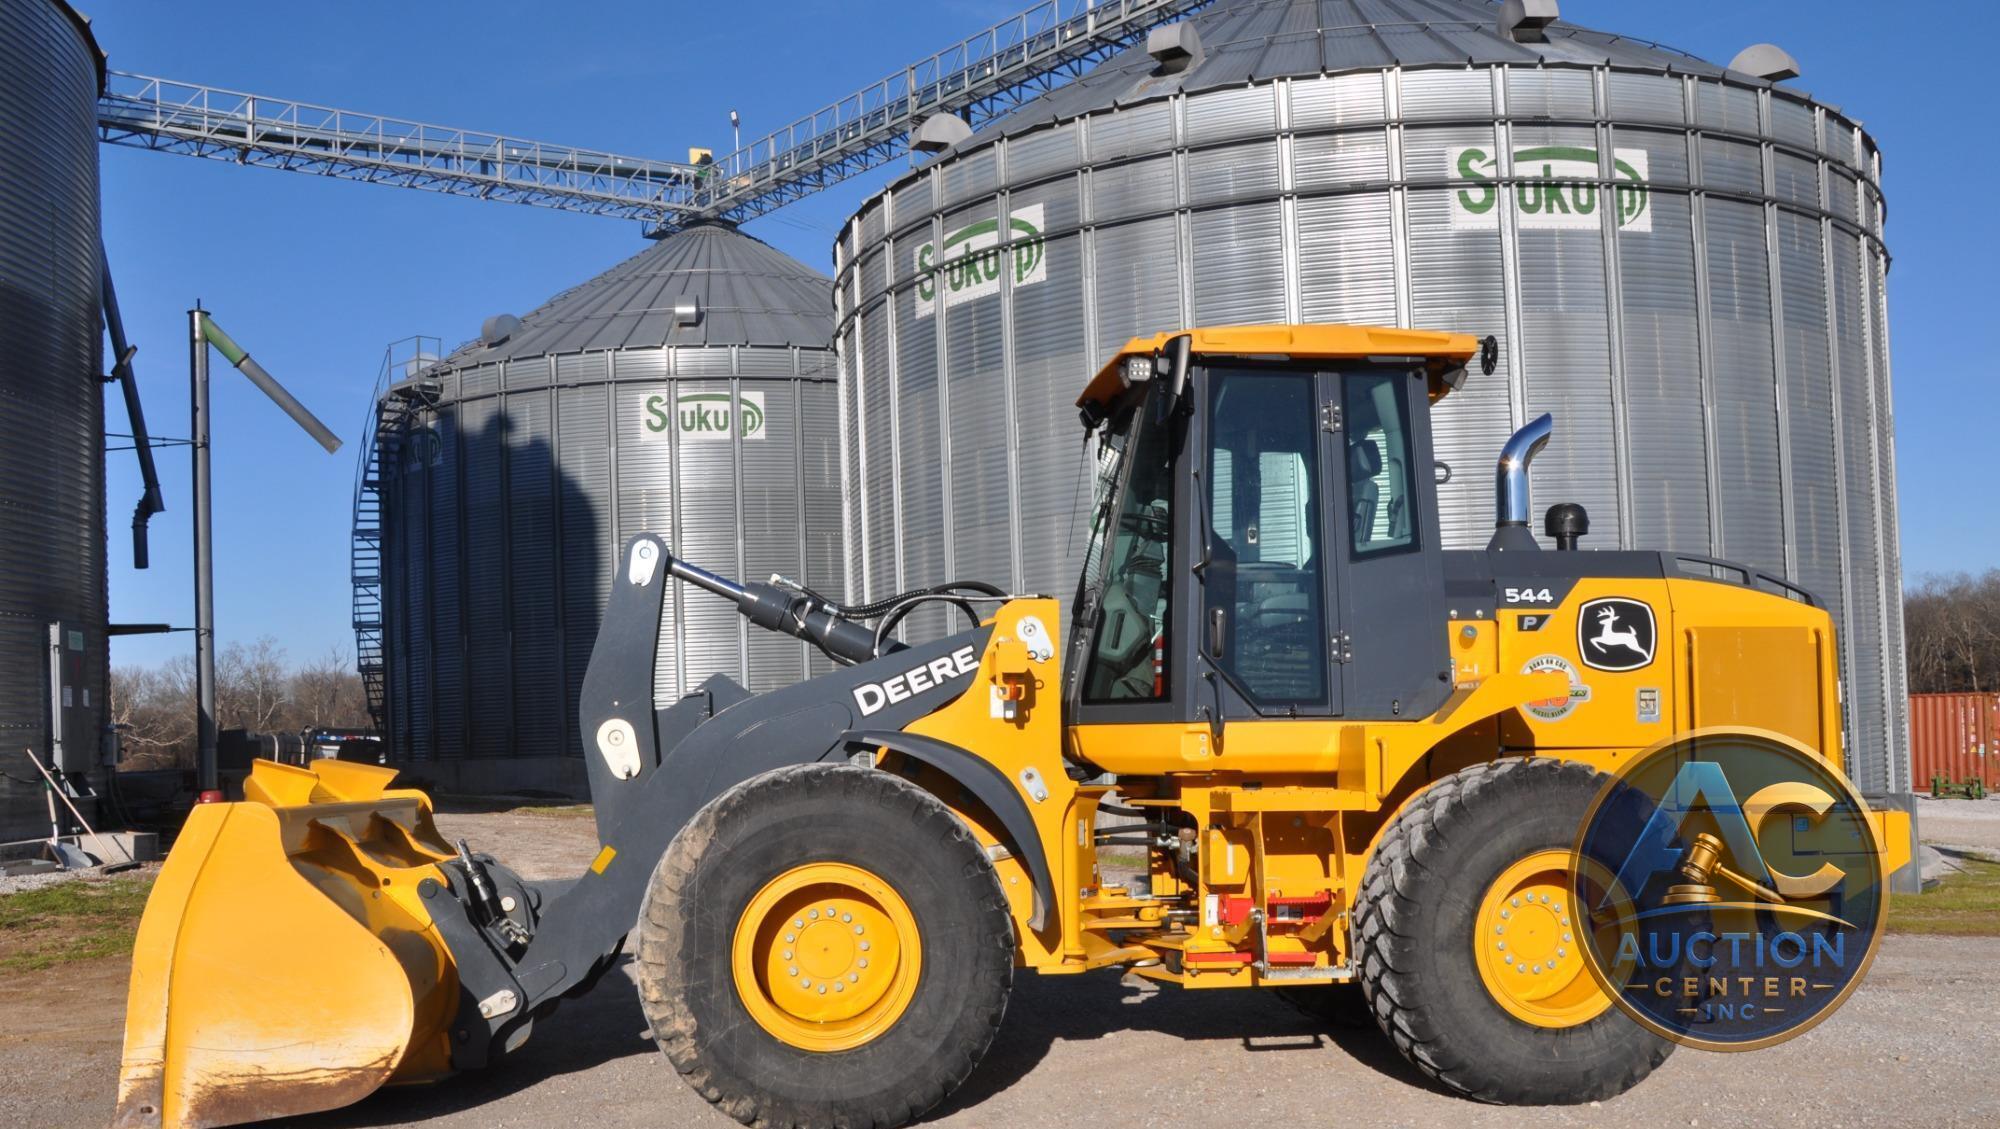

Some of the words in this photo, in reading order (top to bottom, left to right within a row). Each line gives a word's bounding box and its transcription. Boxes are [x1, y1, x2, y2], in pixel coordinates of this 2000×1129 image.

[1457, 147, 1648, 227] Sukup
[918, 217, 1043, 302] Sukup
[645, 393, 764, 437] Sukup
[1504, 588, 1554, 603] 544
[1522, 615, 1538, 630] P
[852, 645, 981, 717] DEERE
